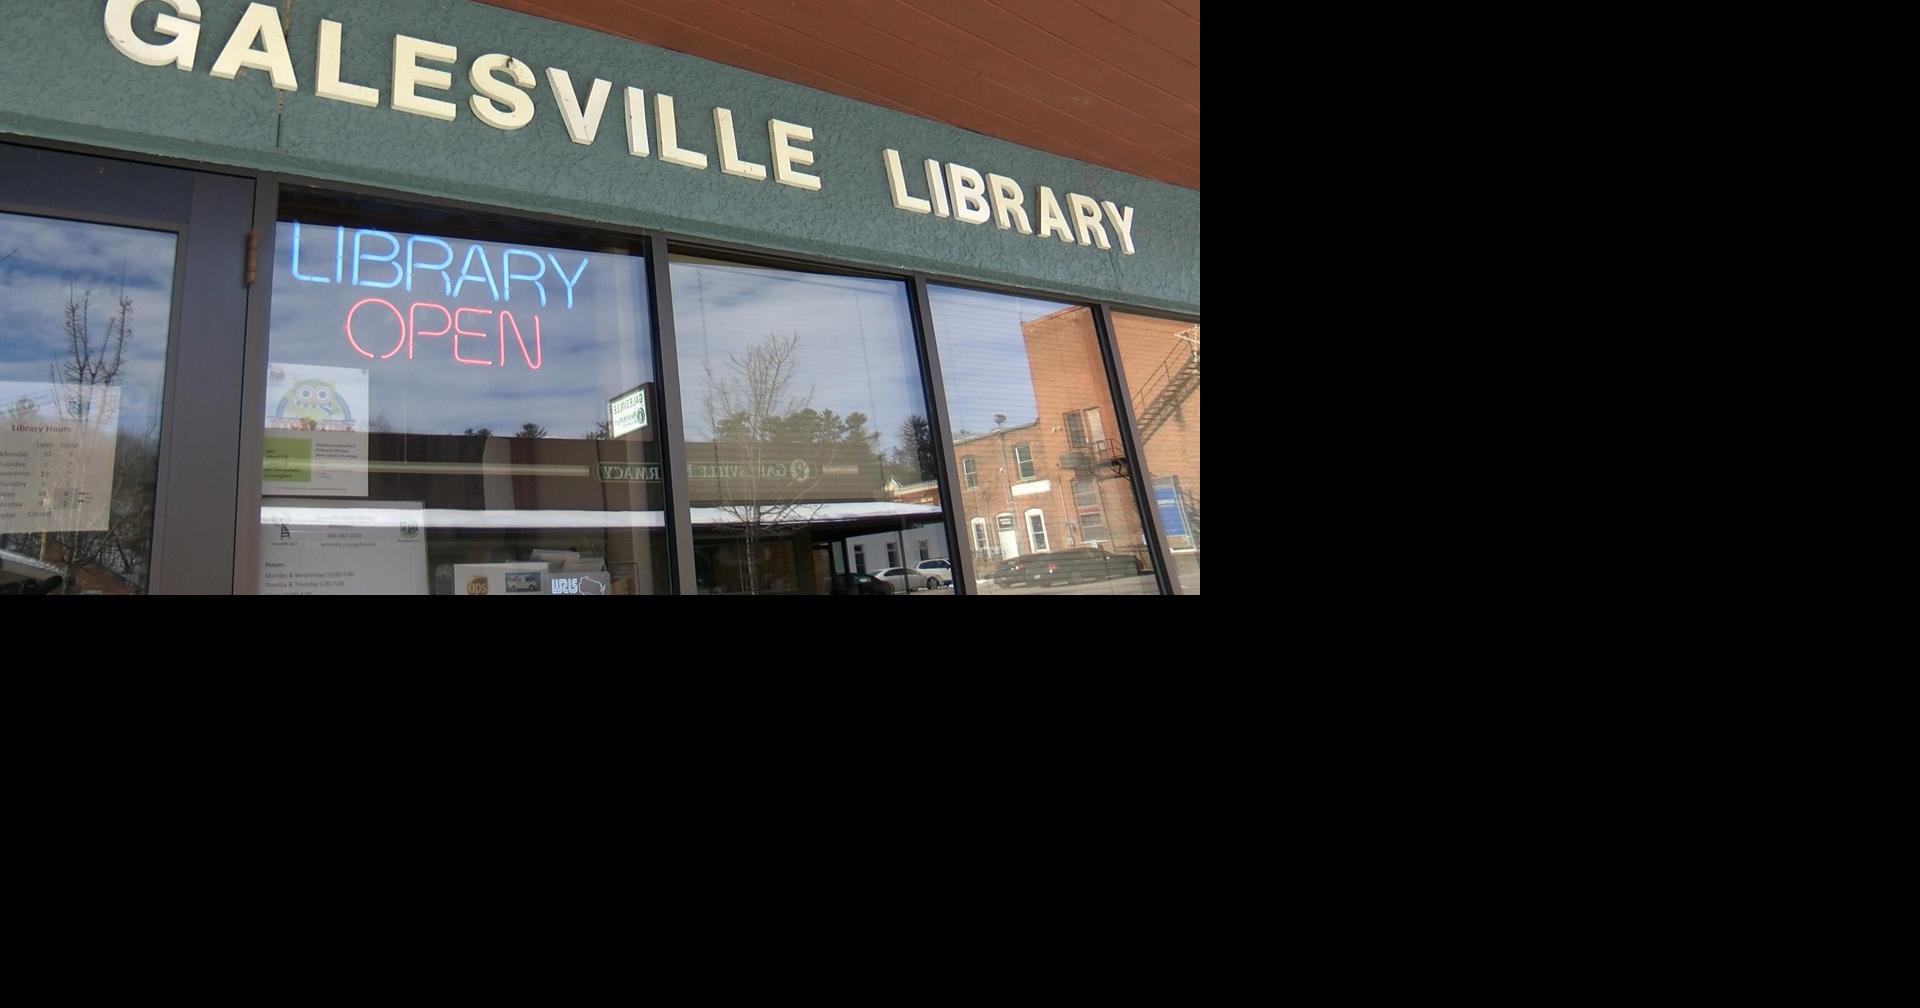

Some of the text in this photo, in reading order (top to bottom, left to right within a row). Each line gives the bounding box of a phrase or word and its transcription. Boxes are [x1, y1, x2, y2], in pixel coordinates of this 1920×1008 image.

[104, 0, 1135, 255] GALESVILLE LIBRARY
[291, 220, 589, 310] LIBRARY
[345, 298, 542, 369] OPEN
[11, 423, 73, 433] Library Hours
